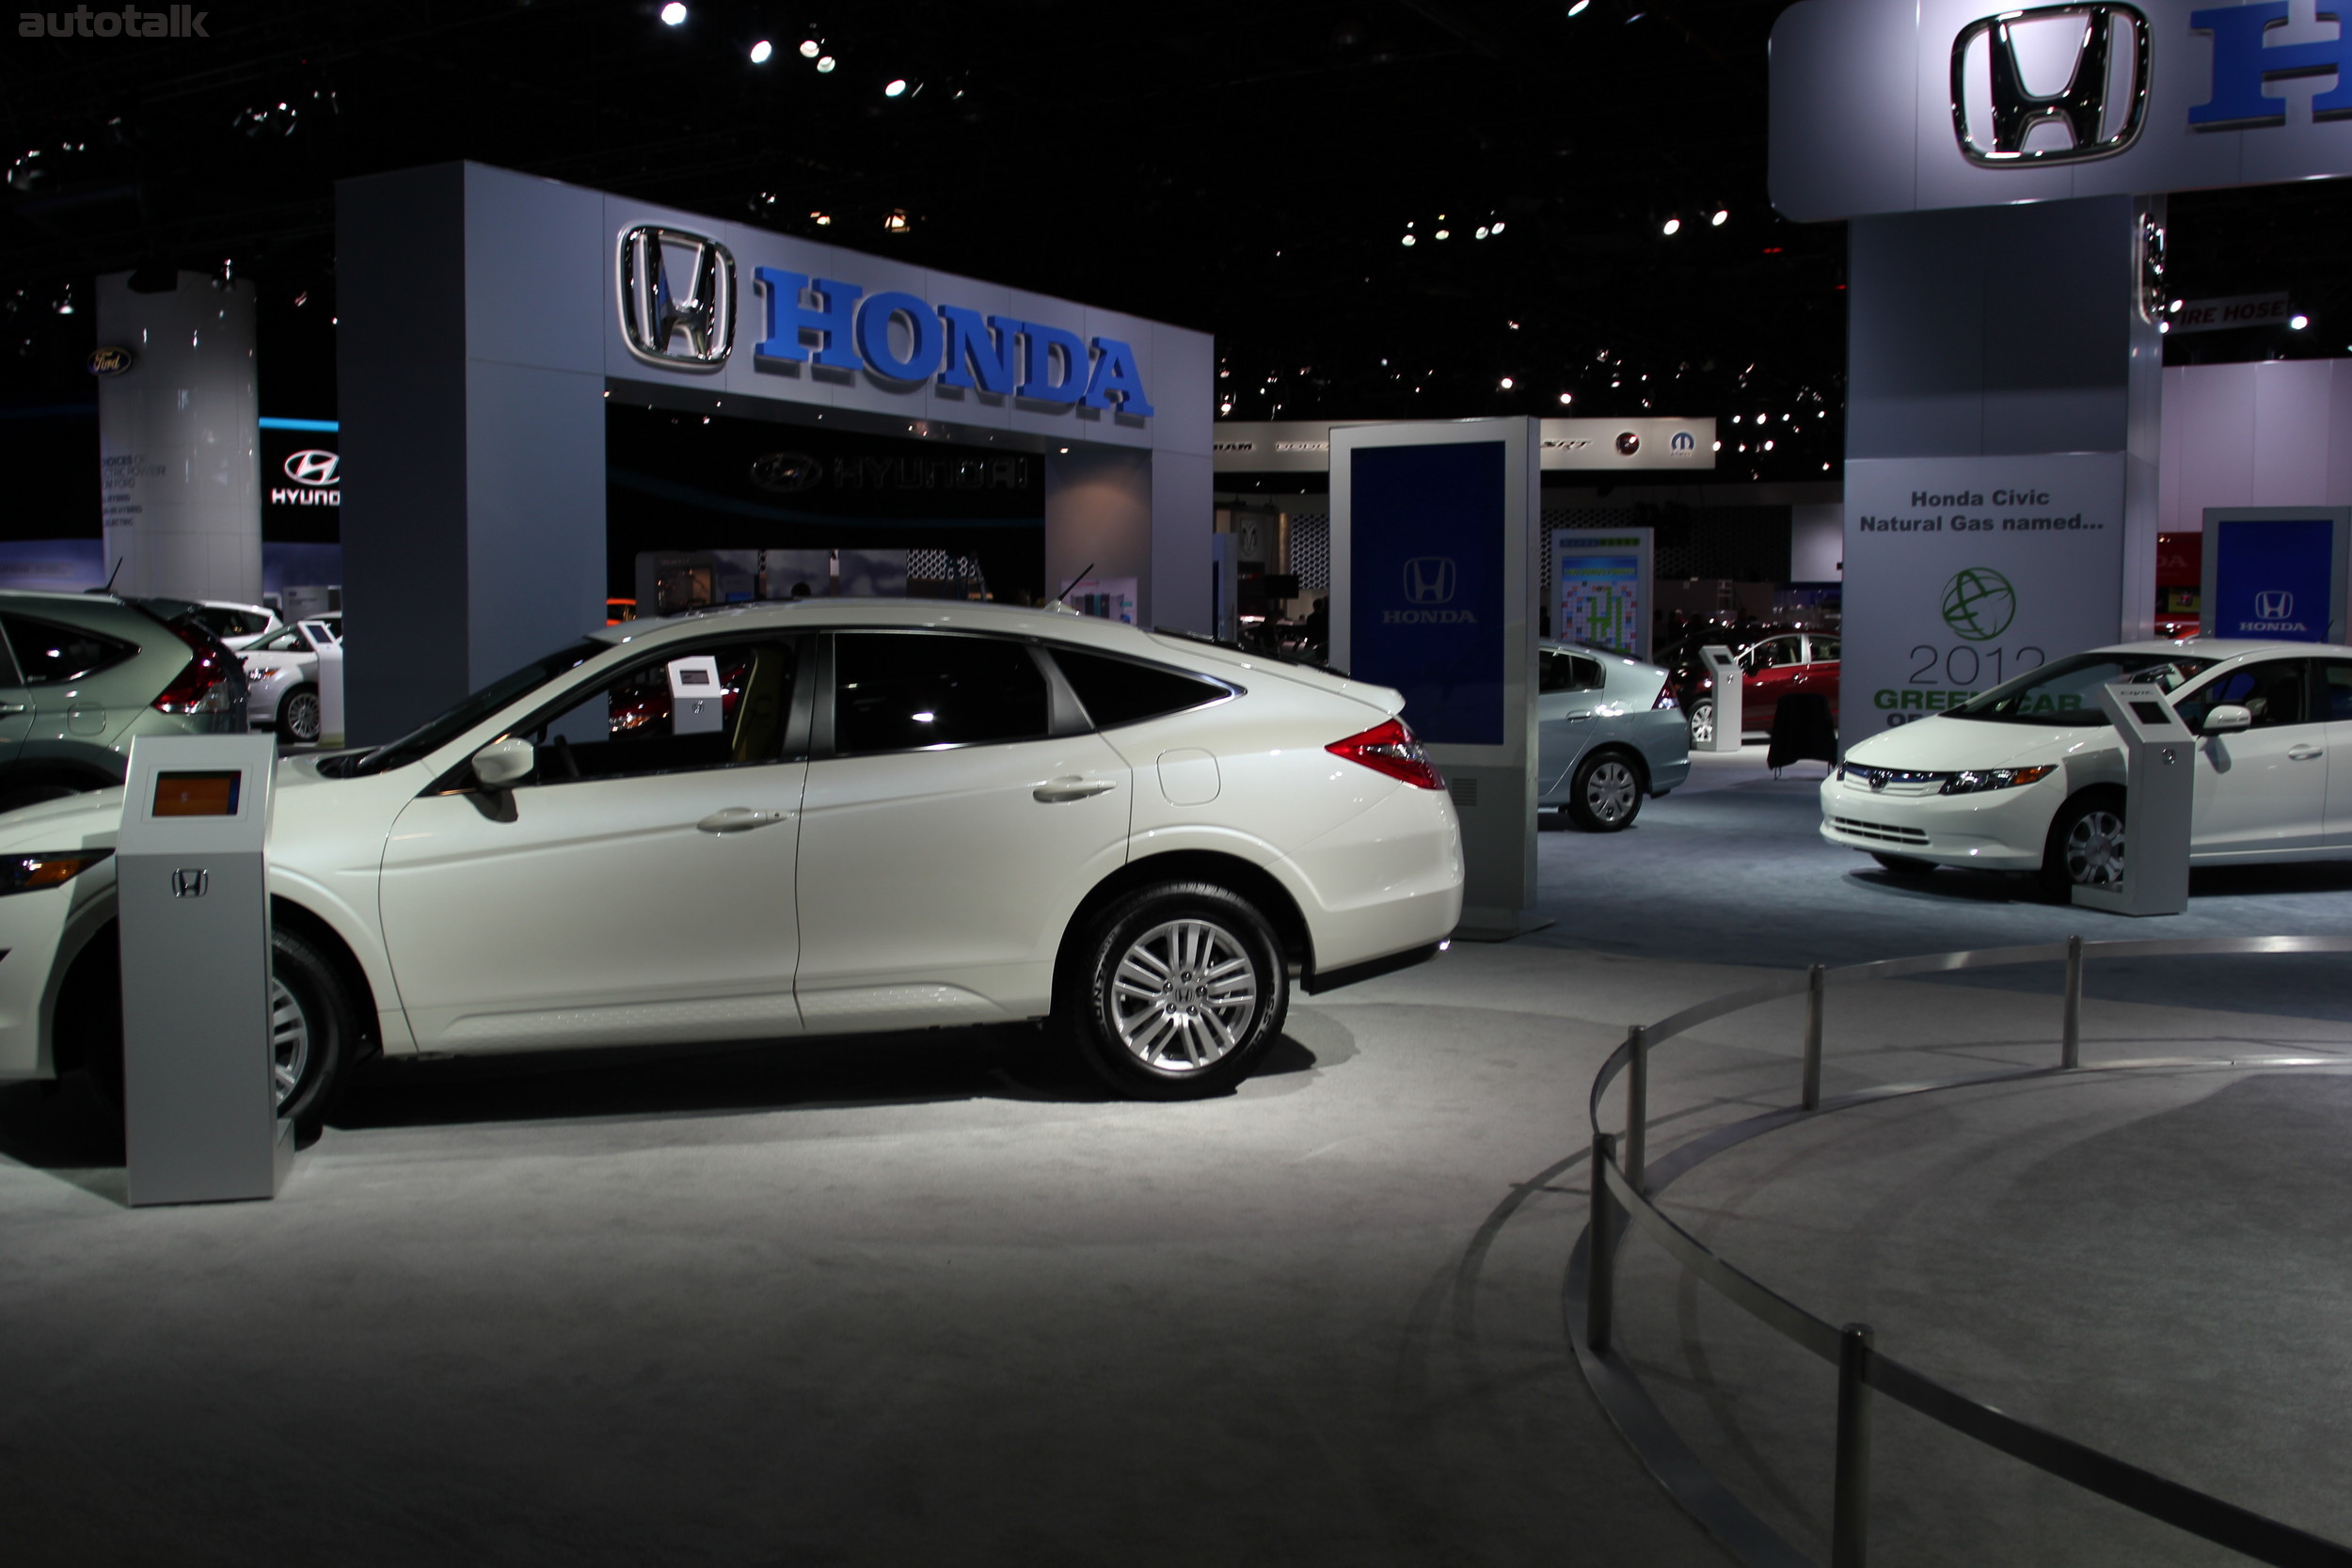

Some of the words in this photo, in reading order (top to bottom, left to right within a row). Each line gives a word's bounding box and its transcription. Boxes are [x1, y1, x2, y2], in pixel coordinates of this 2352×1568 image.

[2176, 306, 2217, 326] IRE
[2222, 299, 2285, 322] HOSE
[755, 266, 1154, 417] HONDA
[94, 351, 120, 372] Ford
[833, 455, 1029, 490] HYUNDAI
[271, 487, 340, 507] HYUND
[1911, 491, 1984, 508] Honda
[1992, 489, 2051, 506] Civic
[1859, 515, 1943, 532] Natural
[1950, 515, 1994, 532] Gas
[2002, 514, 2104, 531] named...
[1382, 610, 1478, 625] HONDA
[2238, 621, 2307, 632] HONDA
[1873, 689, 1978, 711] GREE
